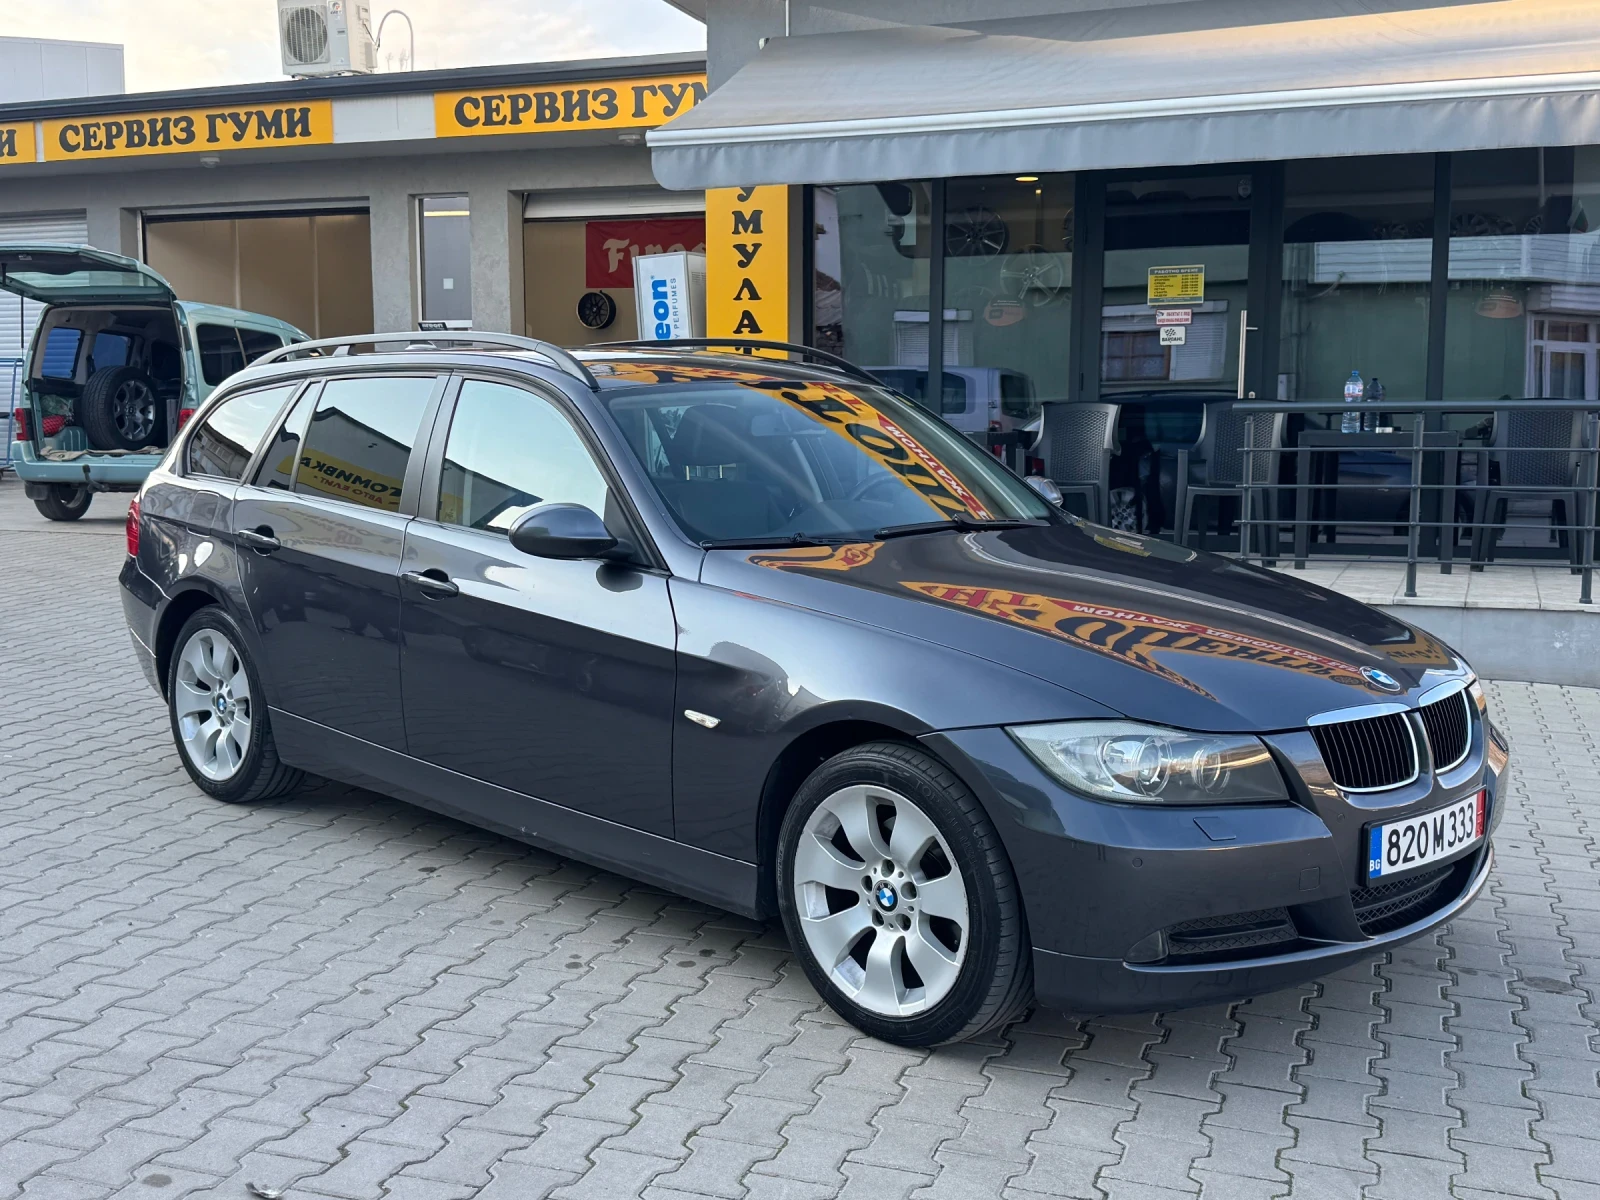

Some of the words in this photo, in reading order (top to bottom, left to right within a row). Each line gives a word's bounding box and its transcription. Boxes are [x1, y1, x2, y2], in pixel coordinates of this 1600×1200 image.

[454, 88, 618, 128] СЕРВИЗ
[59, 115, 196, 152] СЕРВИЗ
[206, 107, 312, 143] ГУМИ
[670, 278, 680, 329] PERFUMES
[1369, 859, 1381, 872] BG
